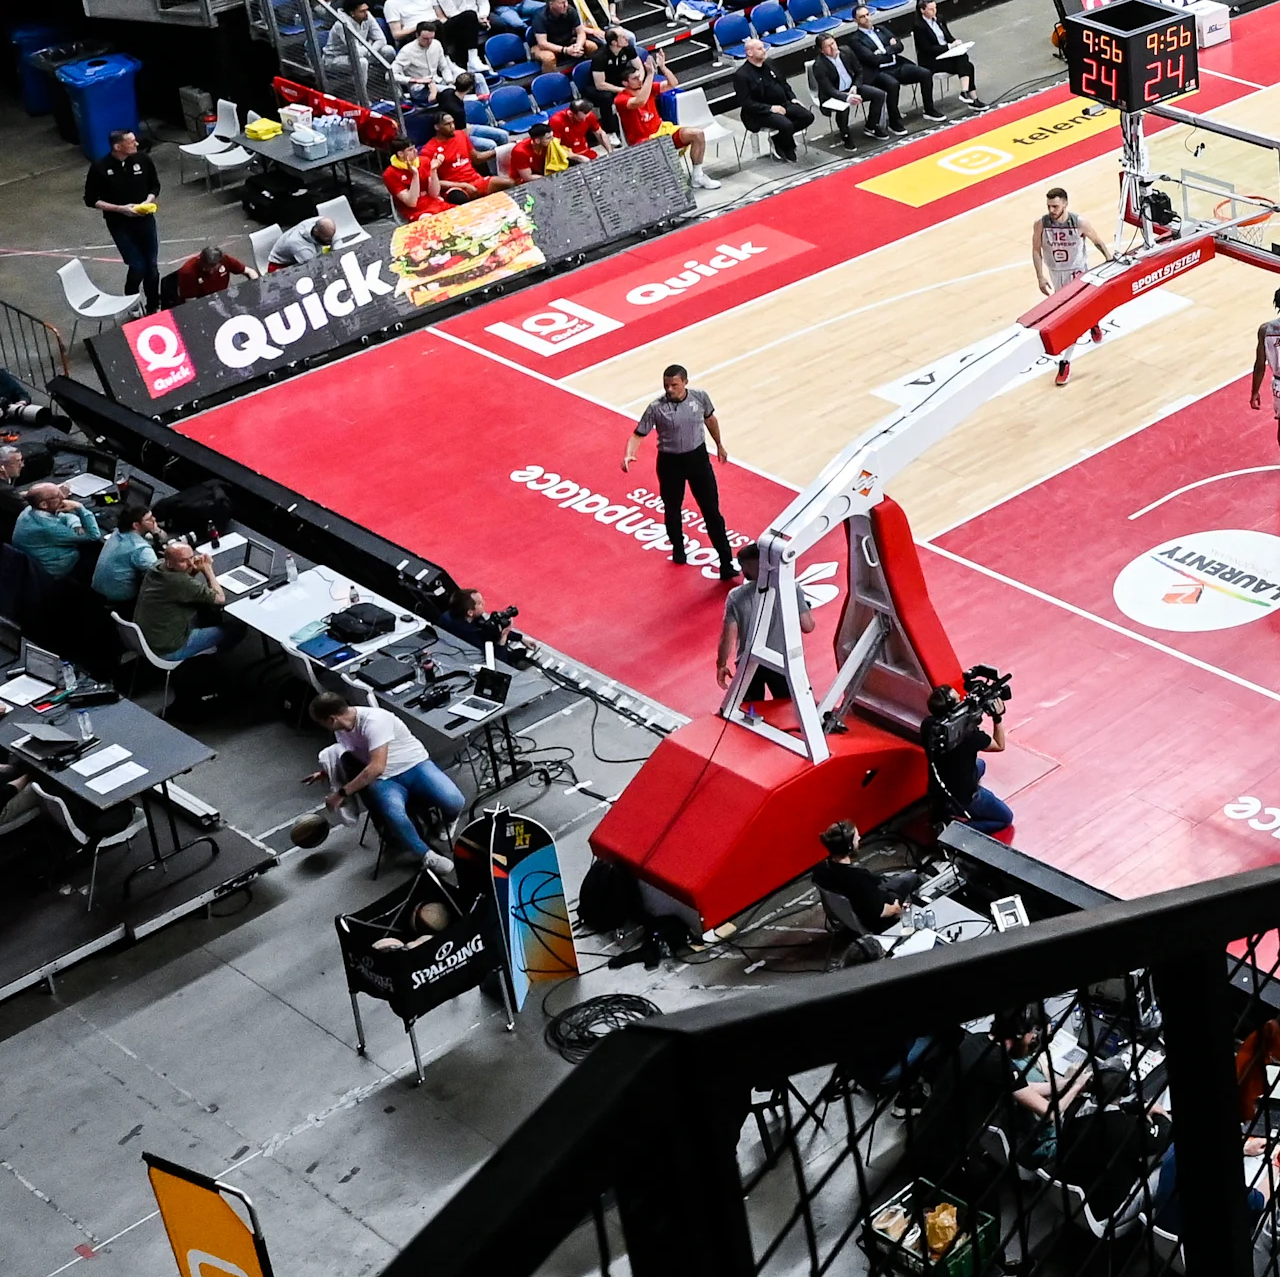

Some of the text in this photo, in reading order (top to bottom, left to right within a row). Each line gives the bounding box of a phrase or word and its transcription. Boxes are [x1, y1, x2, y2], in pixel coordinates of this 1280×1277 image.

[1083, 24, 1191, 63] 9:56 9:56
[1082, 54, 1184, 101] 24 24
[1053, 232, 1066, 241] 12
[626, 238, 767, 305] Quick
[214, 252, 394, 369] Quick
[152, 364, 192, 390] Quick
[412, 934, 486, 989] SPALDING
